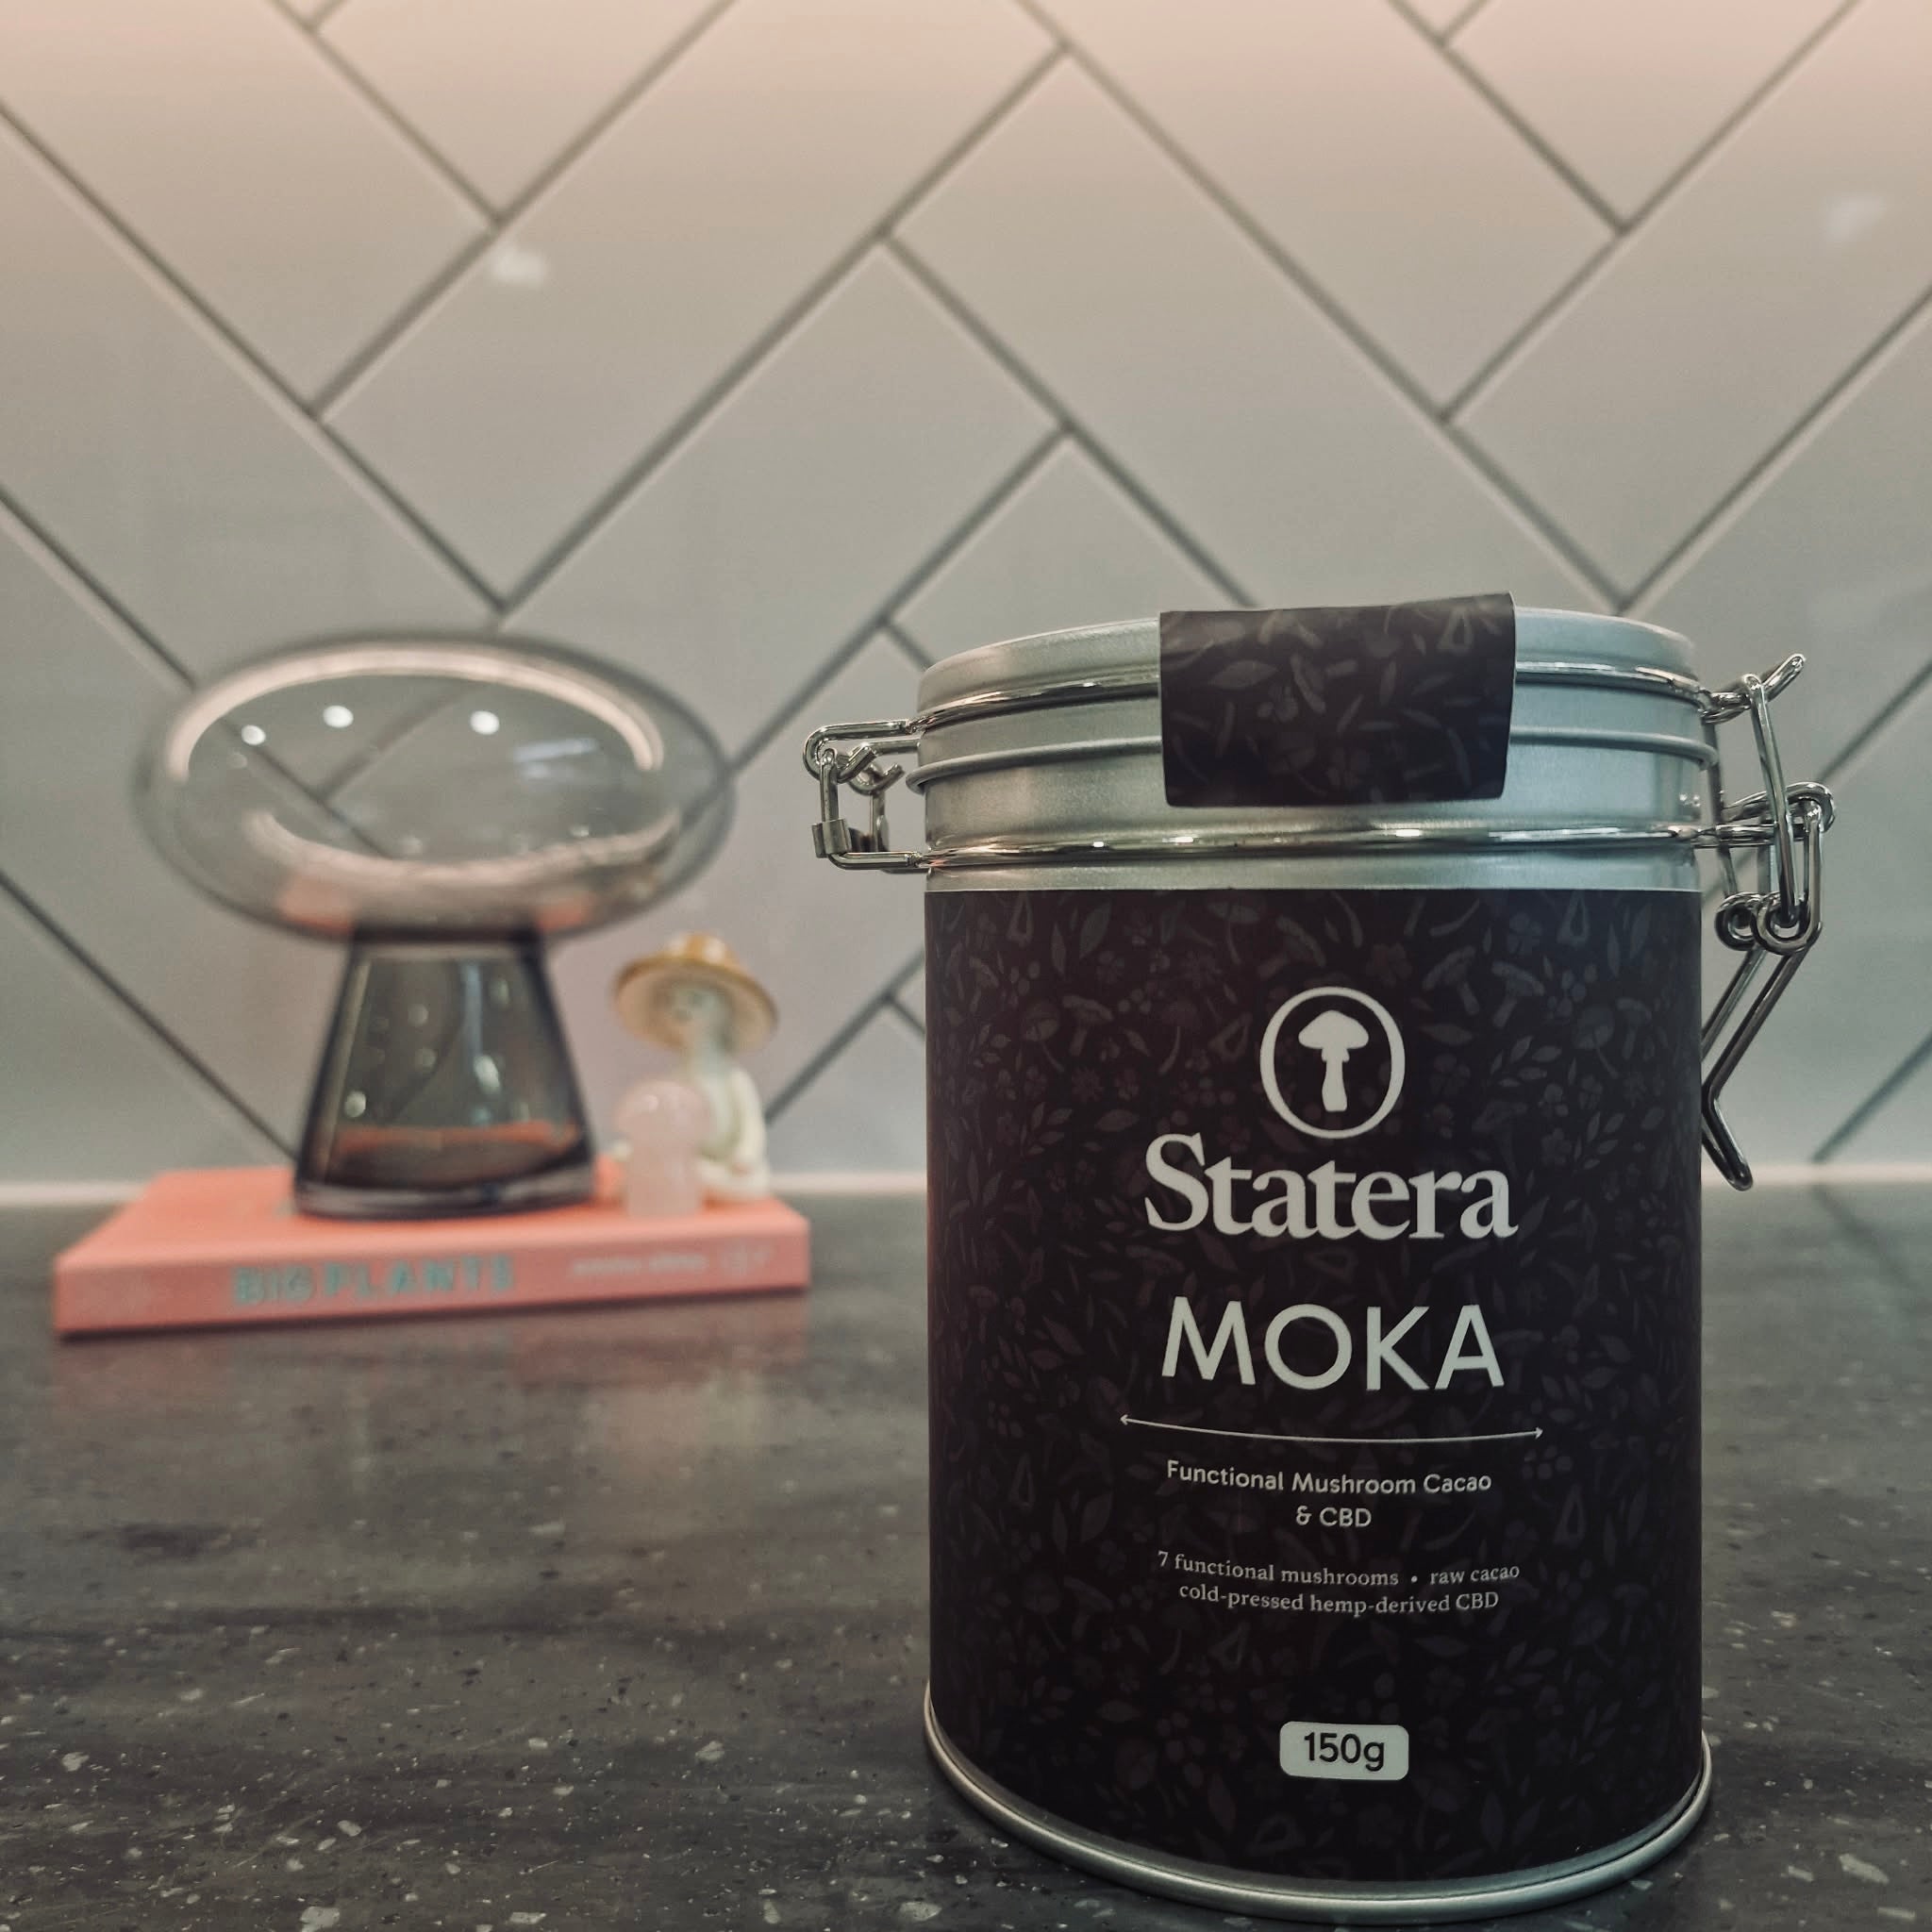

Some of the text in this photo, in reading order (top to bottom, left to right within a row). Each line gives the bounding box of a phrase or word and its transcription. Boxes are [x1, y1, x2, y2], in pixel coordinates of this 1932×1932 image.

[1144, 1132, 1519, 1241] Statera
[232, 1254, 515, 1306] BIG PLANTS
[1161, 1296, 1505, 1391] MOKA
[1167, 1459, 1492, 1494] Functional Mushroom Cacao
[1295, 1505, 1373, 1527] & CBD
[1158, 1550, 1520, 1586] 7 functional mushrooms raw cacao
[1179, 1583, 1499, 1618] cold-pressed hemp-derived CBD
[1304, 1732, 1386, 1772] 150g
